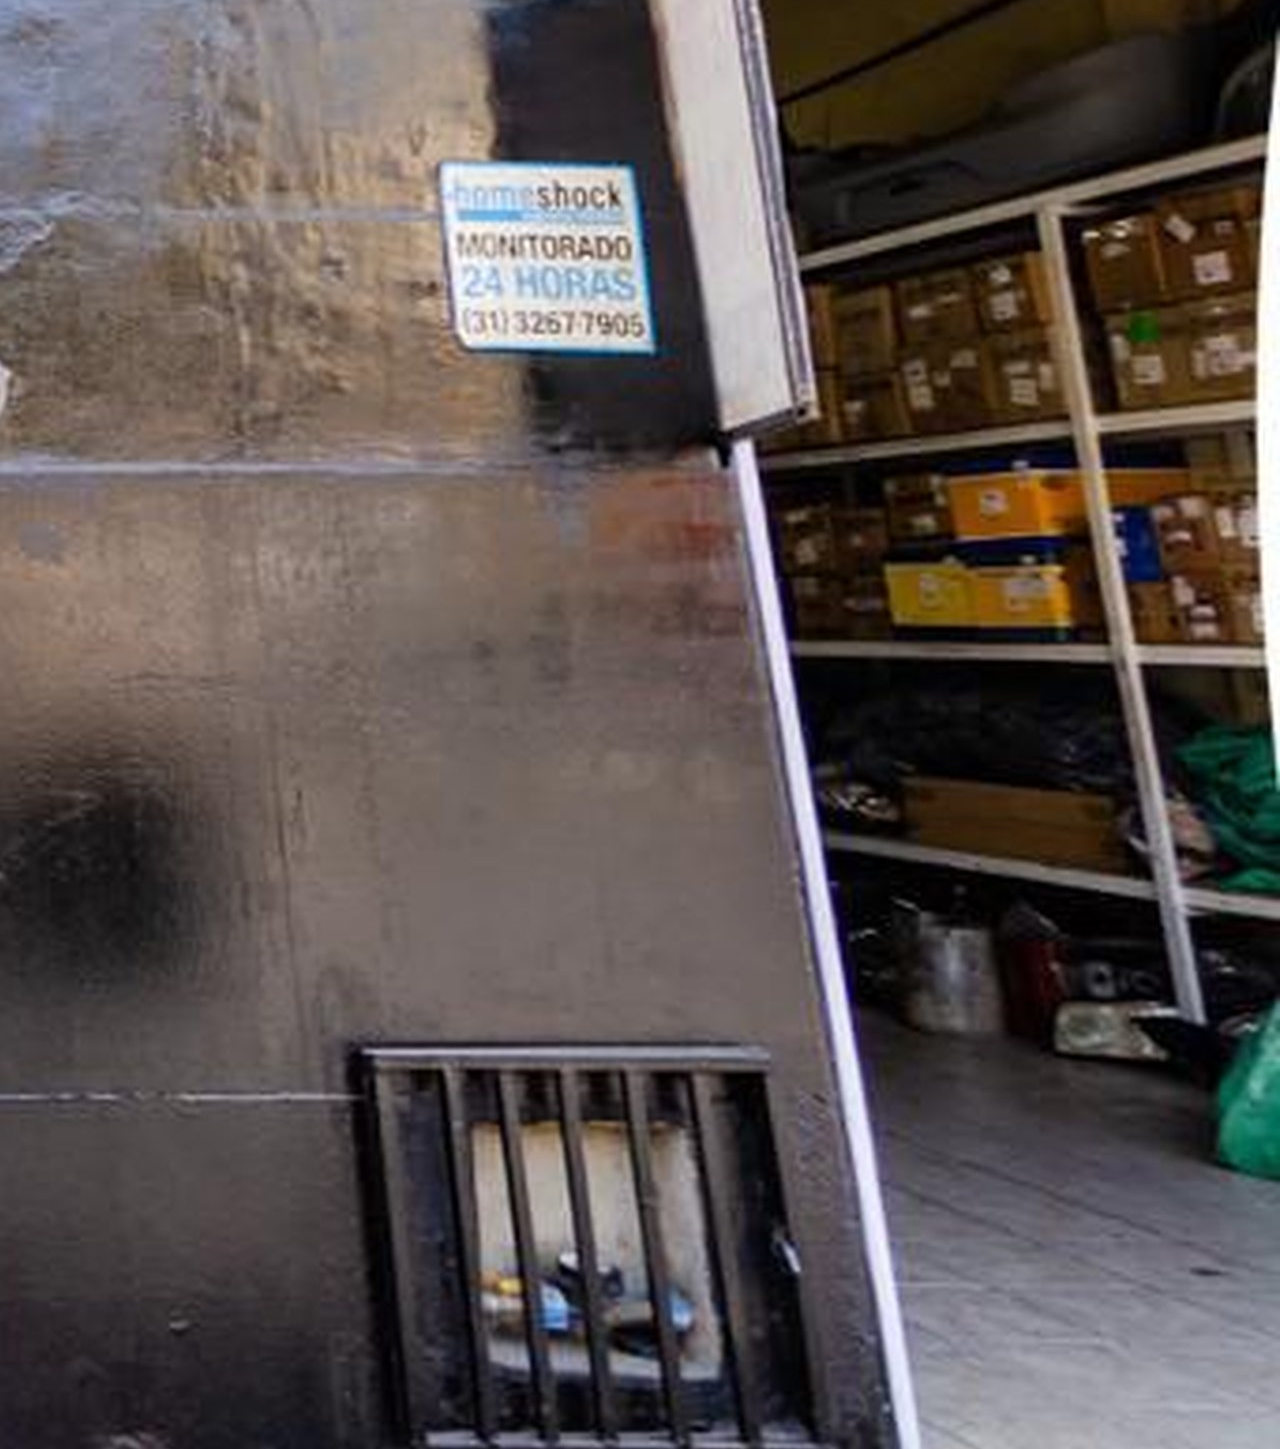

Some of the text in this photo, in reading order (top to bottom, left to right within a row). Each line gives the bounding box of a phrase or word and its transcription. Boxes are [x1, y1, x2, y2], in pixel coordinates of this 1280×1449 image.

[454, 179, 622, 210] homeshock
[456, 232, 633, 261] MONITORADO
[462, 267, 638, 302] 24 HORAS
